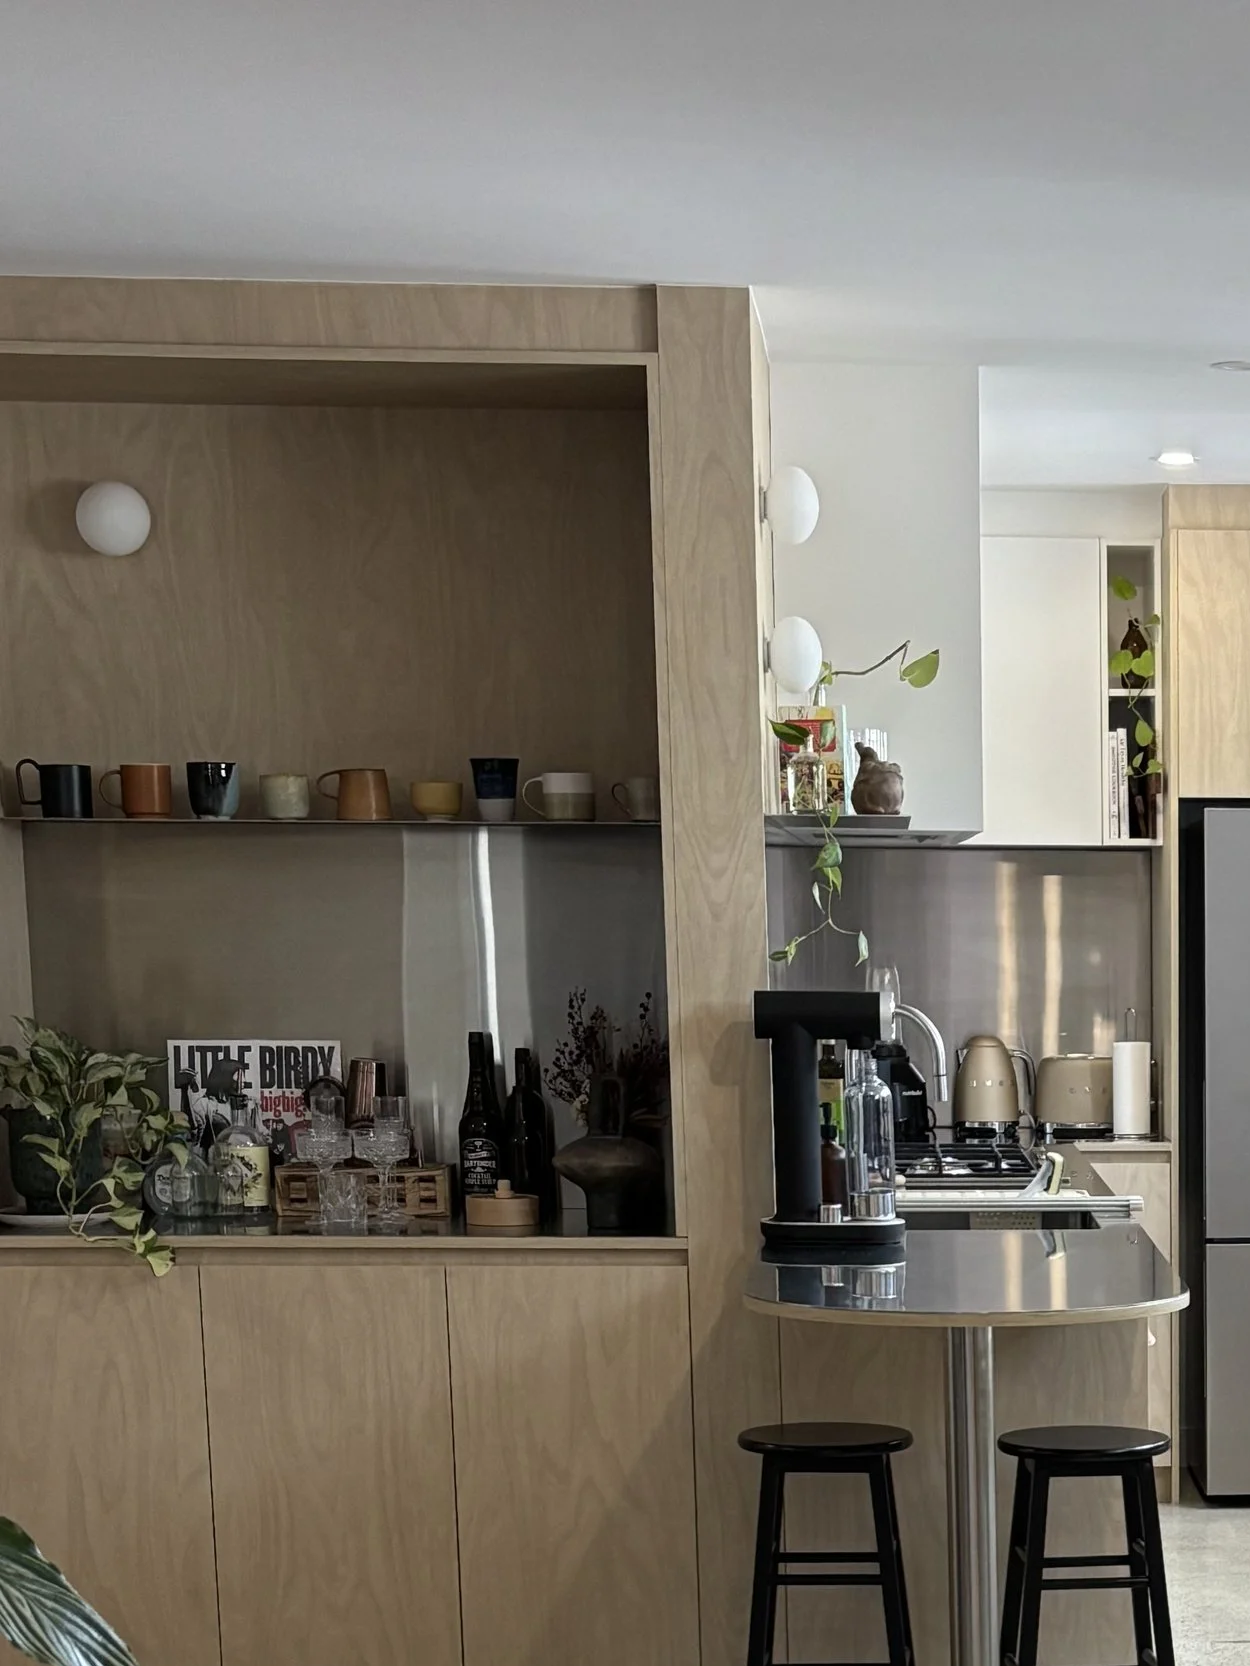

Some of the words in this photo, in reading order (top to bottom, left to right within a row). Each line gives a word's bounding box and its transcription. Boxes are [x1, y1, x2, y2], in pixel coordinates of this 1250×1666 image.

[173, 1045, 253, 1090] LITE
[259, 1045, 336, 1090] BIRDY
[260, 1090, 306, 1118] bigbig
